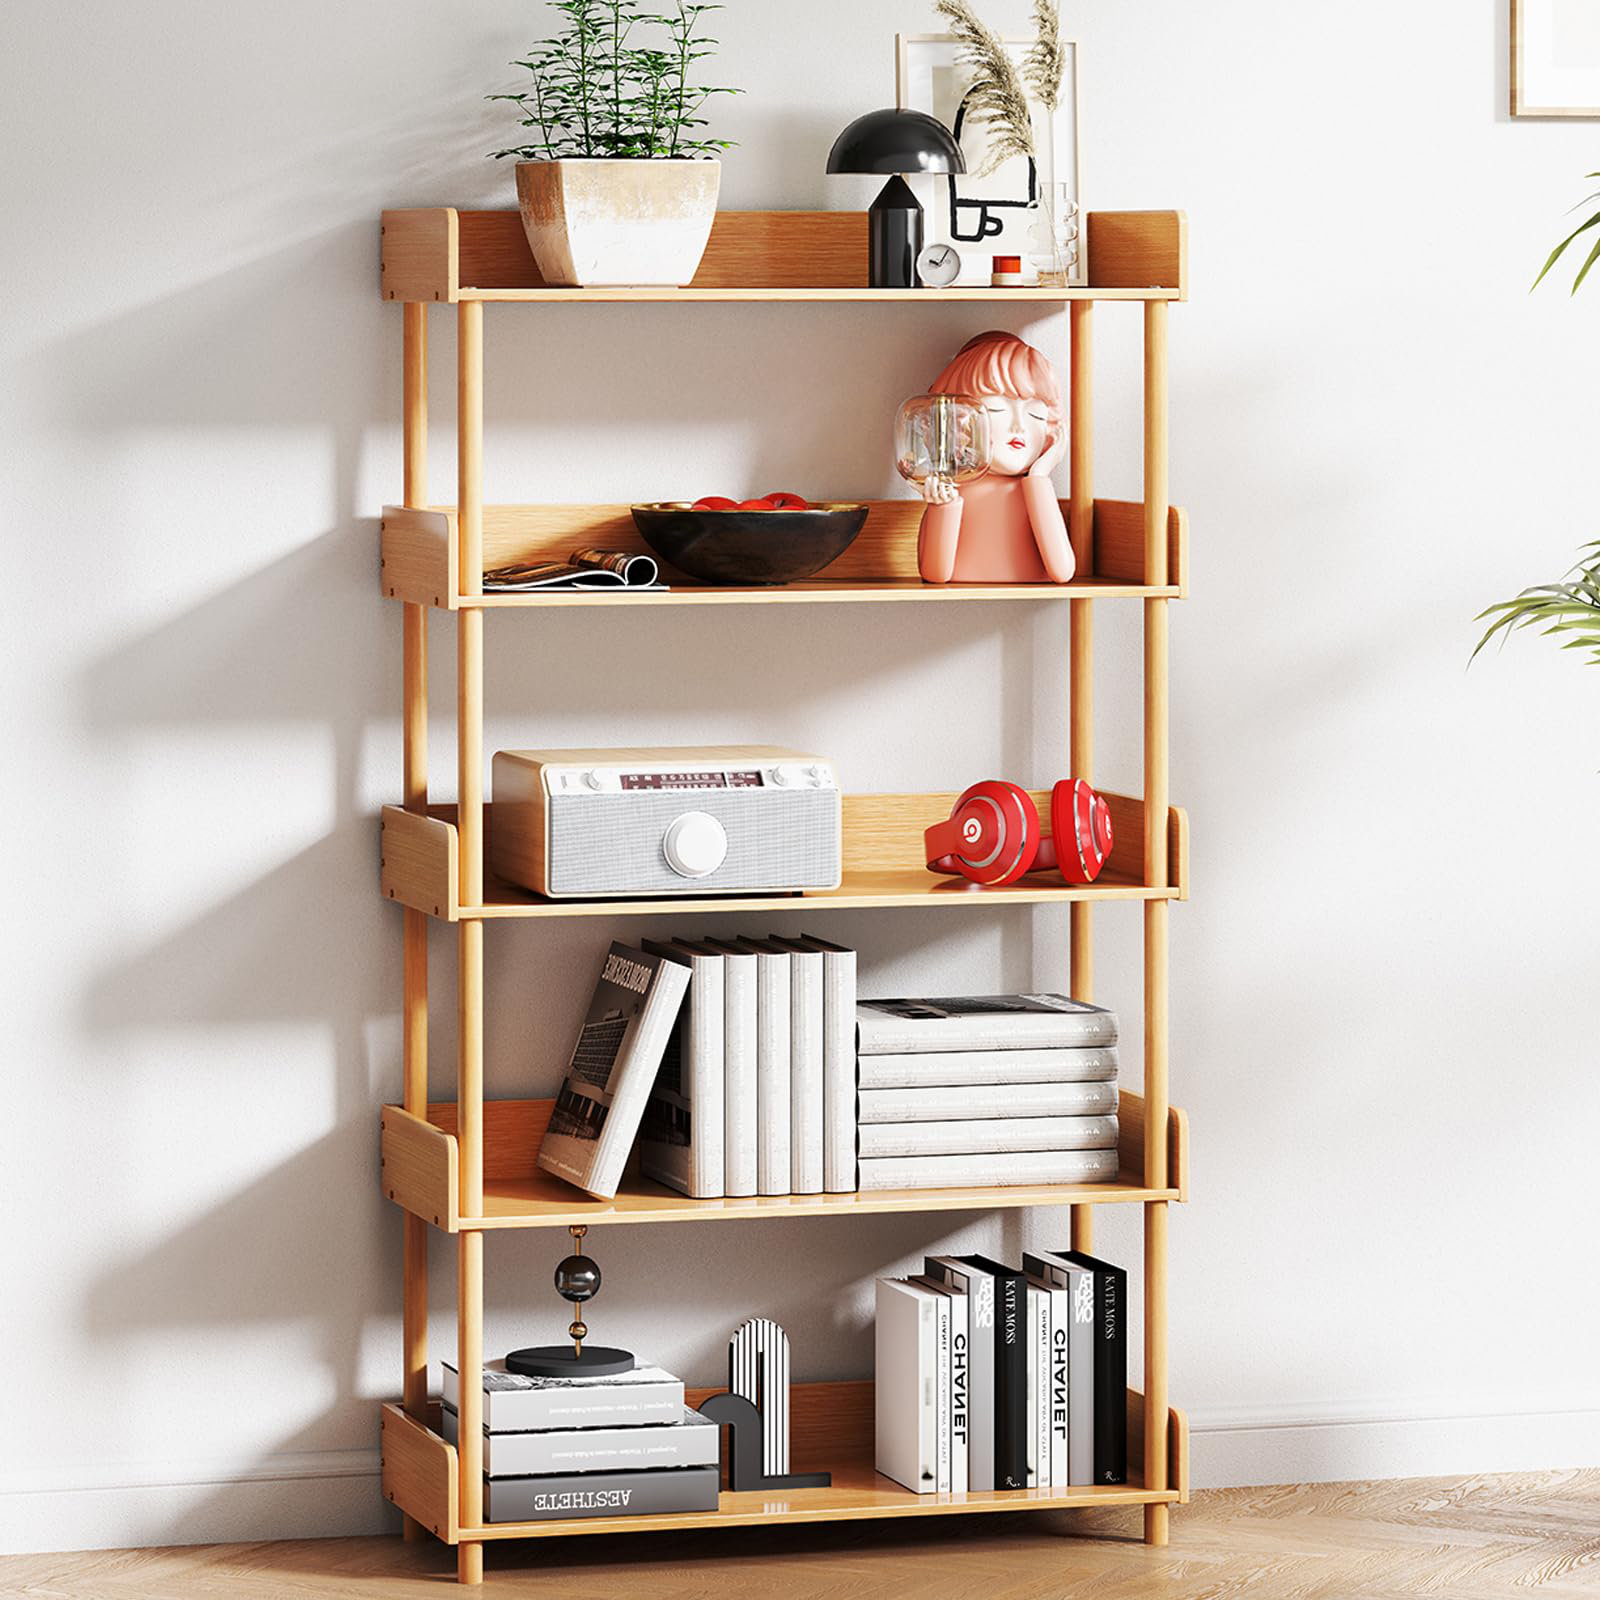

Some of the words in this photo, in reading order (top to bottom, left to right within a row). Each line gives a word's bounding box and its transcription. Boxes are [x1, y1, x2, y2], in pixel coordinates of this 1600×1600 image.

[1005, 1280, 1016, 1311] KATE
[1105, 1276, 1116, 1307] KATE
[1005, 1312, 1016, 1345] MOSS
[1105, 1308, 1116, 1340] MOSS
[534, 1489, 632, 1511] AESTHETE
